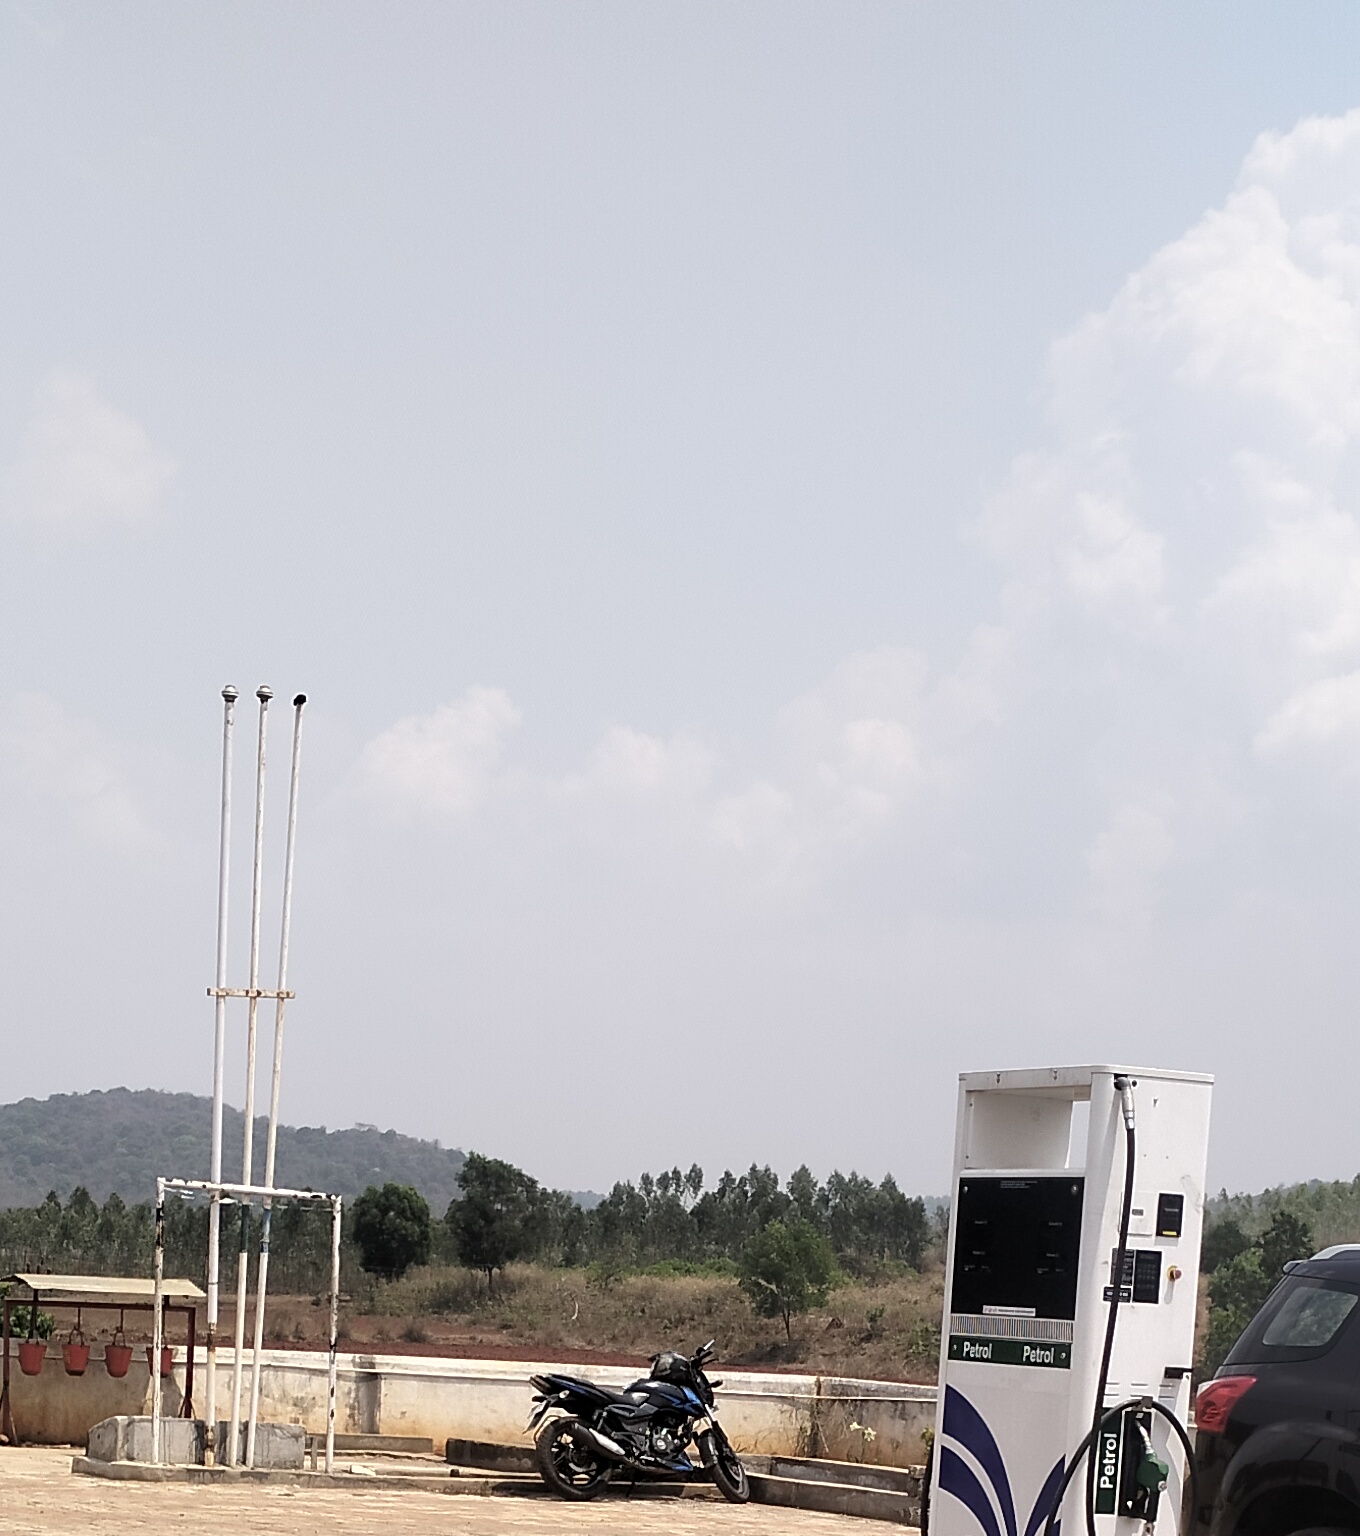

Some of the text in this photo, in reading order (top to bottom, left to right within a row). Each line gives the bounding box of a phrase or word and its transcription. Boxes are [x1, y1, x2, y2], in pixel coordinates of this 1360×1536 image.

[962, 1341, 1055, 1364] Petrol Petrol
[1100, 1433, 1117, 1489] Petrol
